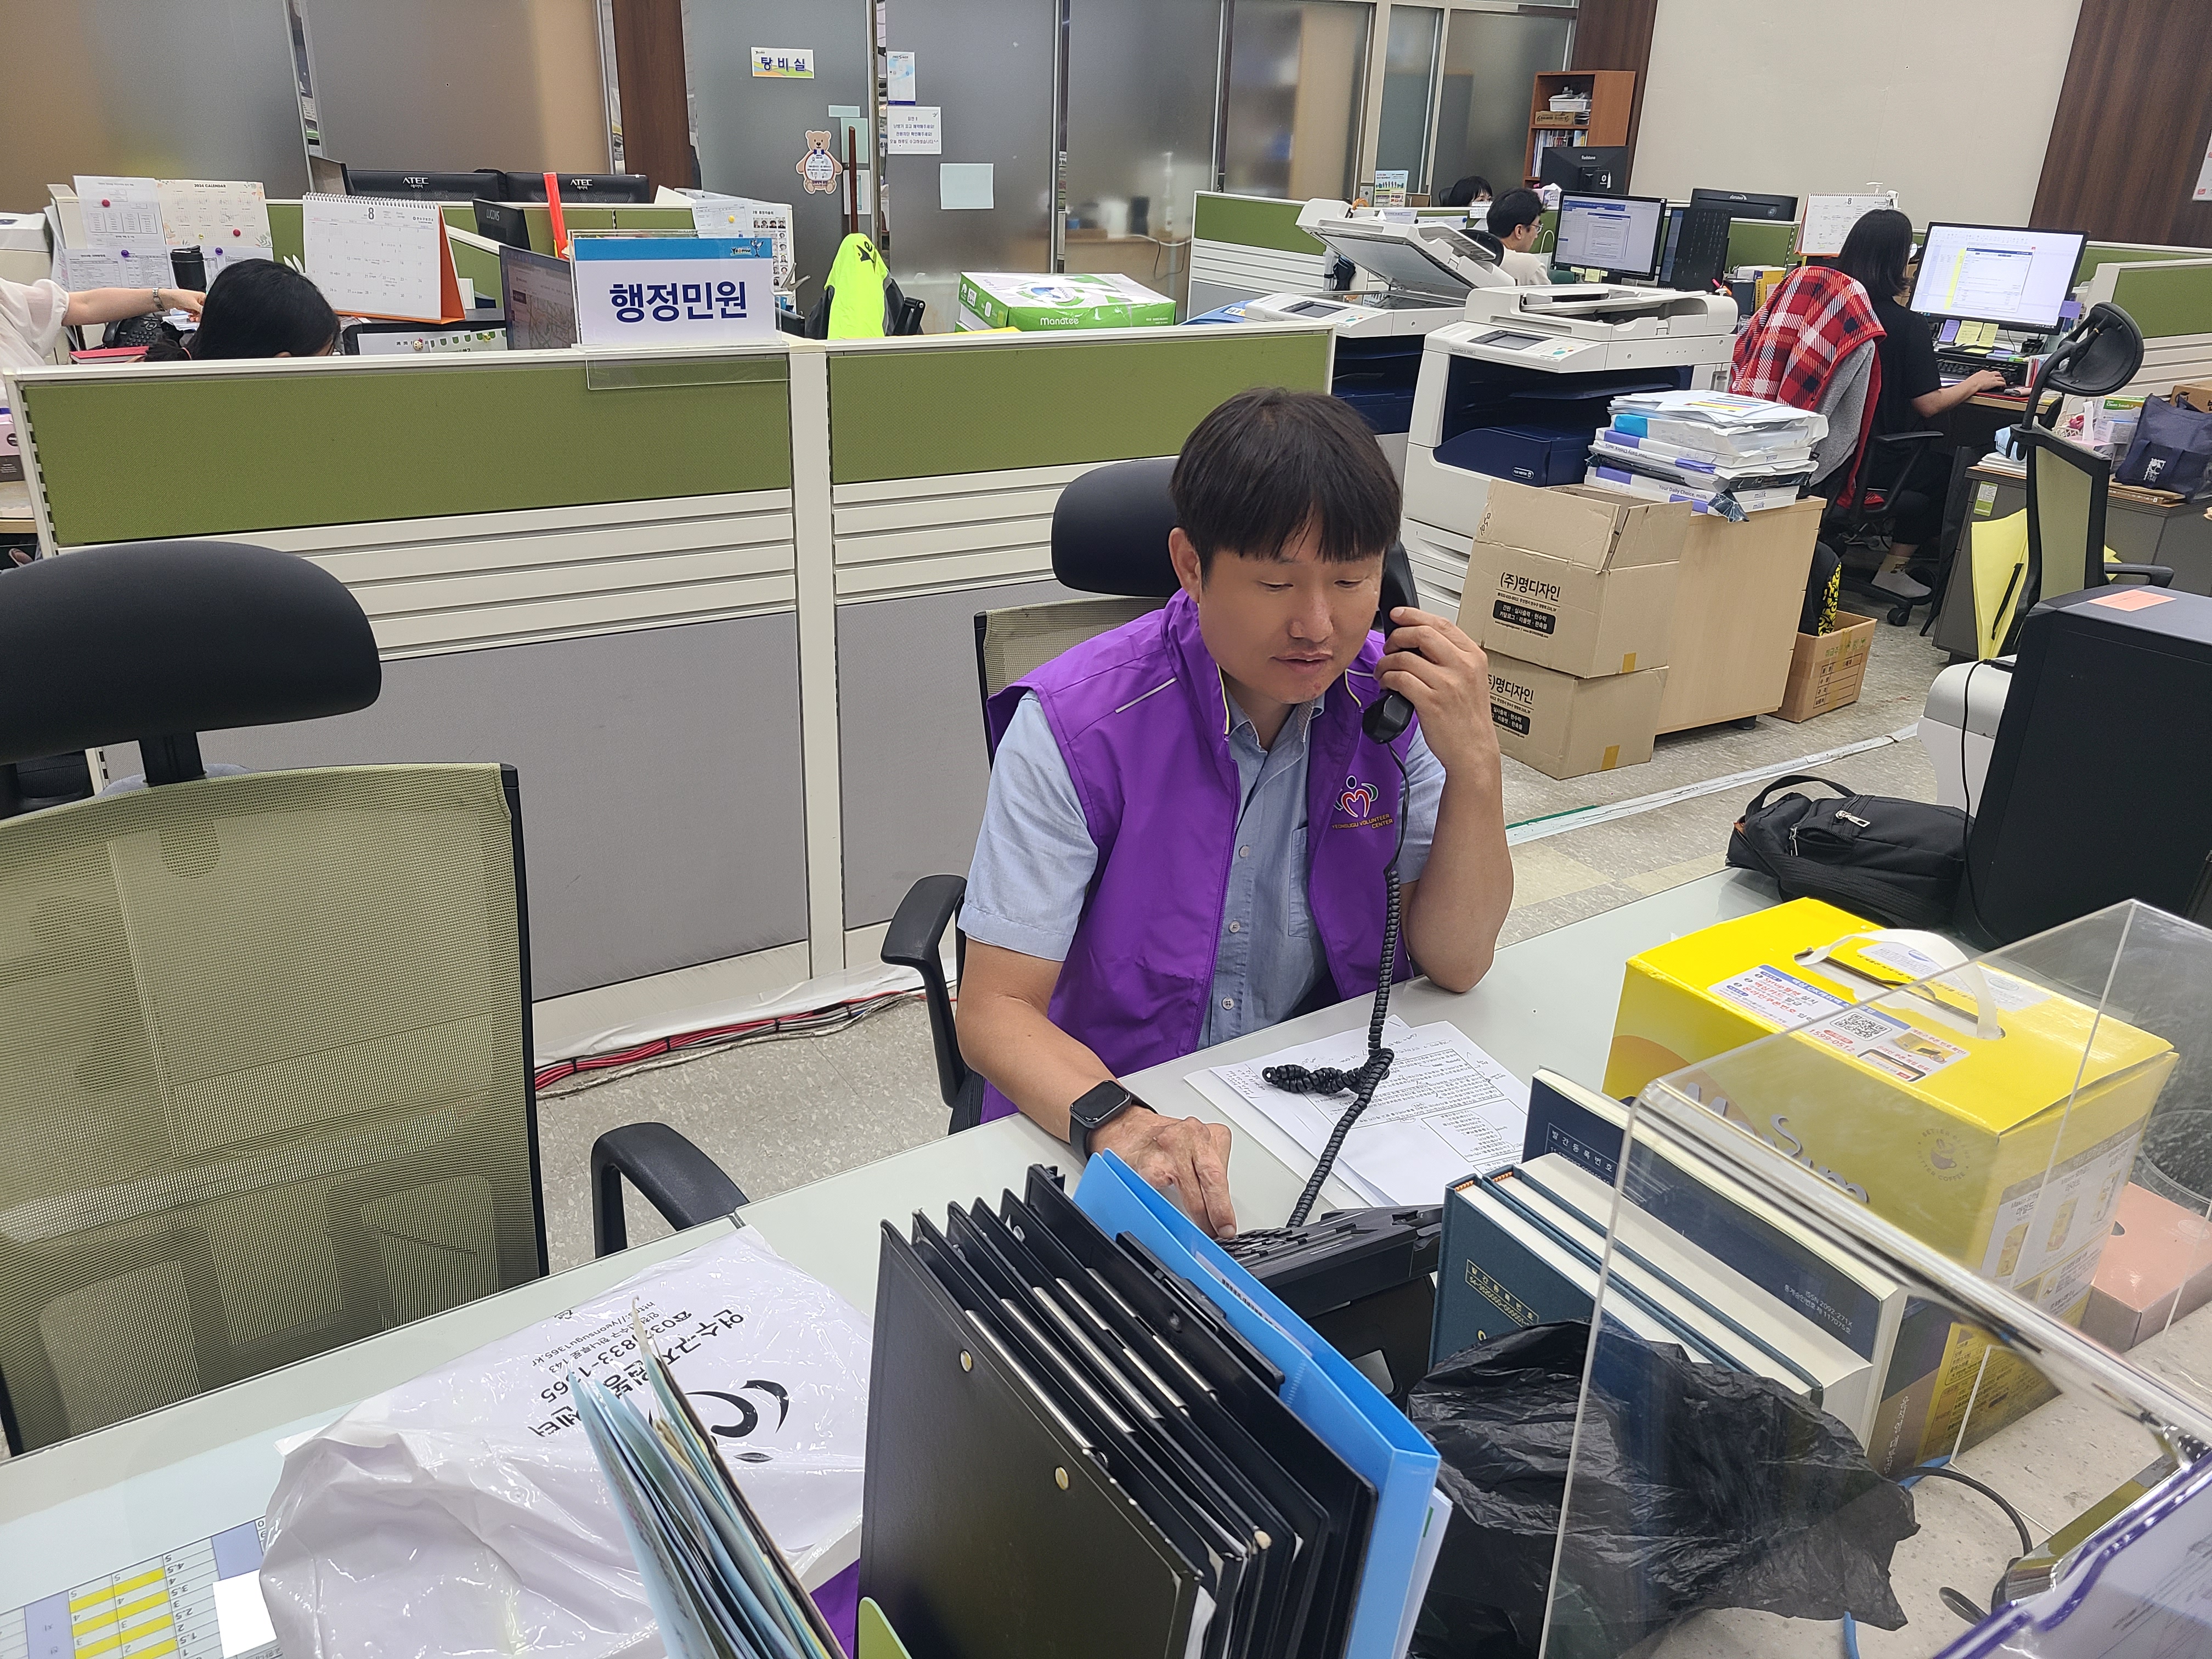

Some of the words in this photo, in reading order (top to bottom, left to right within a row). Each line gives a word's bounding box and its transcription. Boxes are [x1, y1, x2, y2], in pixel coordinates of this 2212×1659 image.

[761, 57, 805, 71] 탕비실
[368, 207, 375, 219] 8
[609, 281, 747, 323] 행정민원
[1040, 317, 1079, 325] Manatee
[1680, 489, 1695, 498] Choice,
[1500, 572, 1561, 602] (주)명디자인
[1514, 607, 1531, 618] 실사출력
[1534, 613, 1547, 622] 현수막
[1535, 621, 1548, 630] 판촉물
[1488, 673, 1534, 705] )명디자인
[1493, 707, 1508, 717] 실사출력
[1510, 713, 1522, 723] 현수막
[1331, 821, 1359, 830] YEONSUGU
[1359, 814, 1390, 827] VOLUNTEER
[1372, 819, 1393, 830] CENTER
[1790, 978, 1808, 988] 맥심
[1751, 981, 1786, 998] 맥심카드
[1783, 997, 1803, 1007] 발급
[1761, 977, 1802, 996] Syrup월렛
[1799, 995, 1819, 1005] 설치
[1740, 986, 1798, 1014] 온라인쿠폰번호
[1807, 1028, 1856, 1052] 1599-0512
[1552, 1130, 1612, 1172] 발간등록번호
[1938, 1171, 1966, 1182] COFFEE
[2065, 1180, 2080, 1192] 라이트
[2011, 1199, 2026, 1209] Maxim
[2016, 1201, 2035, 1216] 마일드
[1471, 1266, 1534, 1321] 발간등록번호
[1784, 1284, 1816, 1310] 통계승인번호
[1816, 1306, 1822, 1314] 제
[1824, 1311, 1852, 1335] 117075호
[1805, 1290, 1819, 1304] ISSN
[1819, 1300, 1853, 1328] 2092-271X
[639, 1312, 659, 1324] 인천
[569, 1336, 611, 1360] 한나루로
[549, 1357, 569, 1374] 143
[165, 1554, 172, 1562] 5
[167, 1562, 184, 1573] 4.5
[171, 1585, 189, 1596] 3.5
[175, 1608, 193, 1620] 2.5
[177, 1623, 185, 1632] 2
[179, 1633, 198, 1645] 1.5
[124, 1645, 132, 1653] 2
